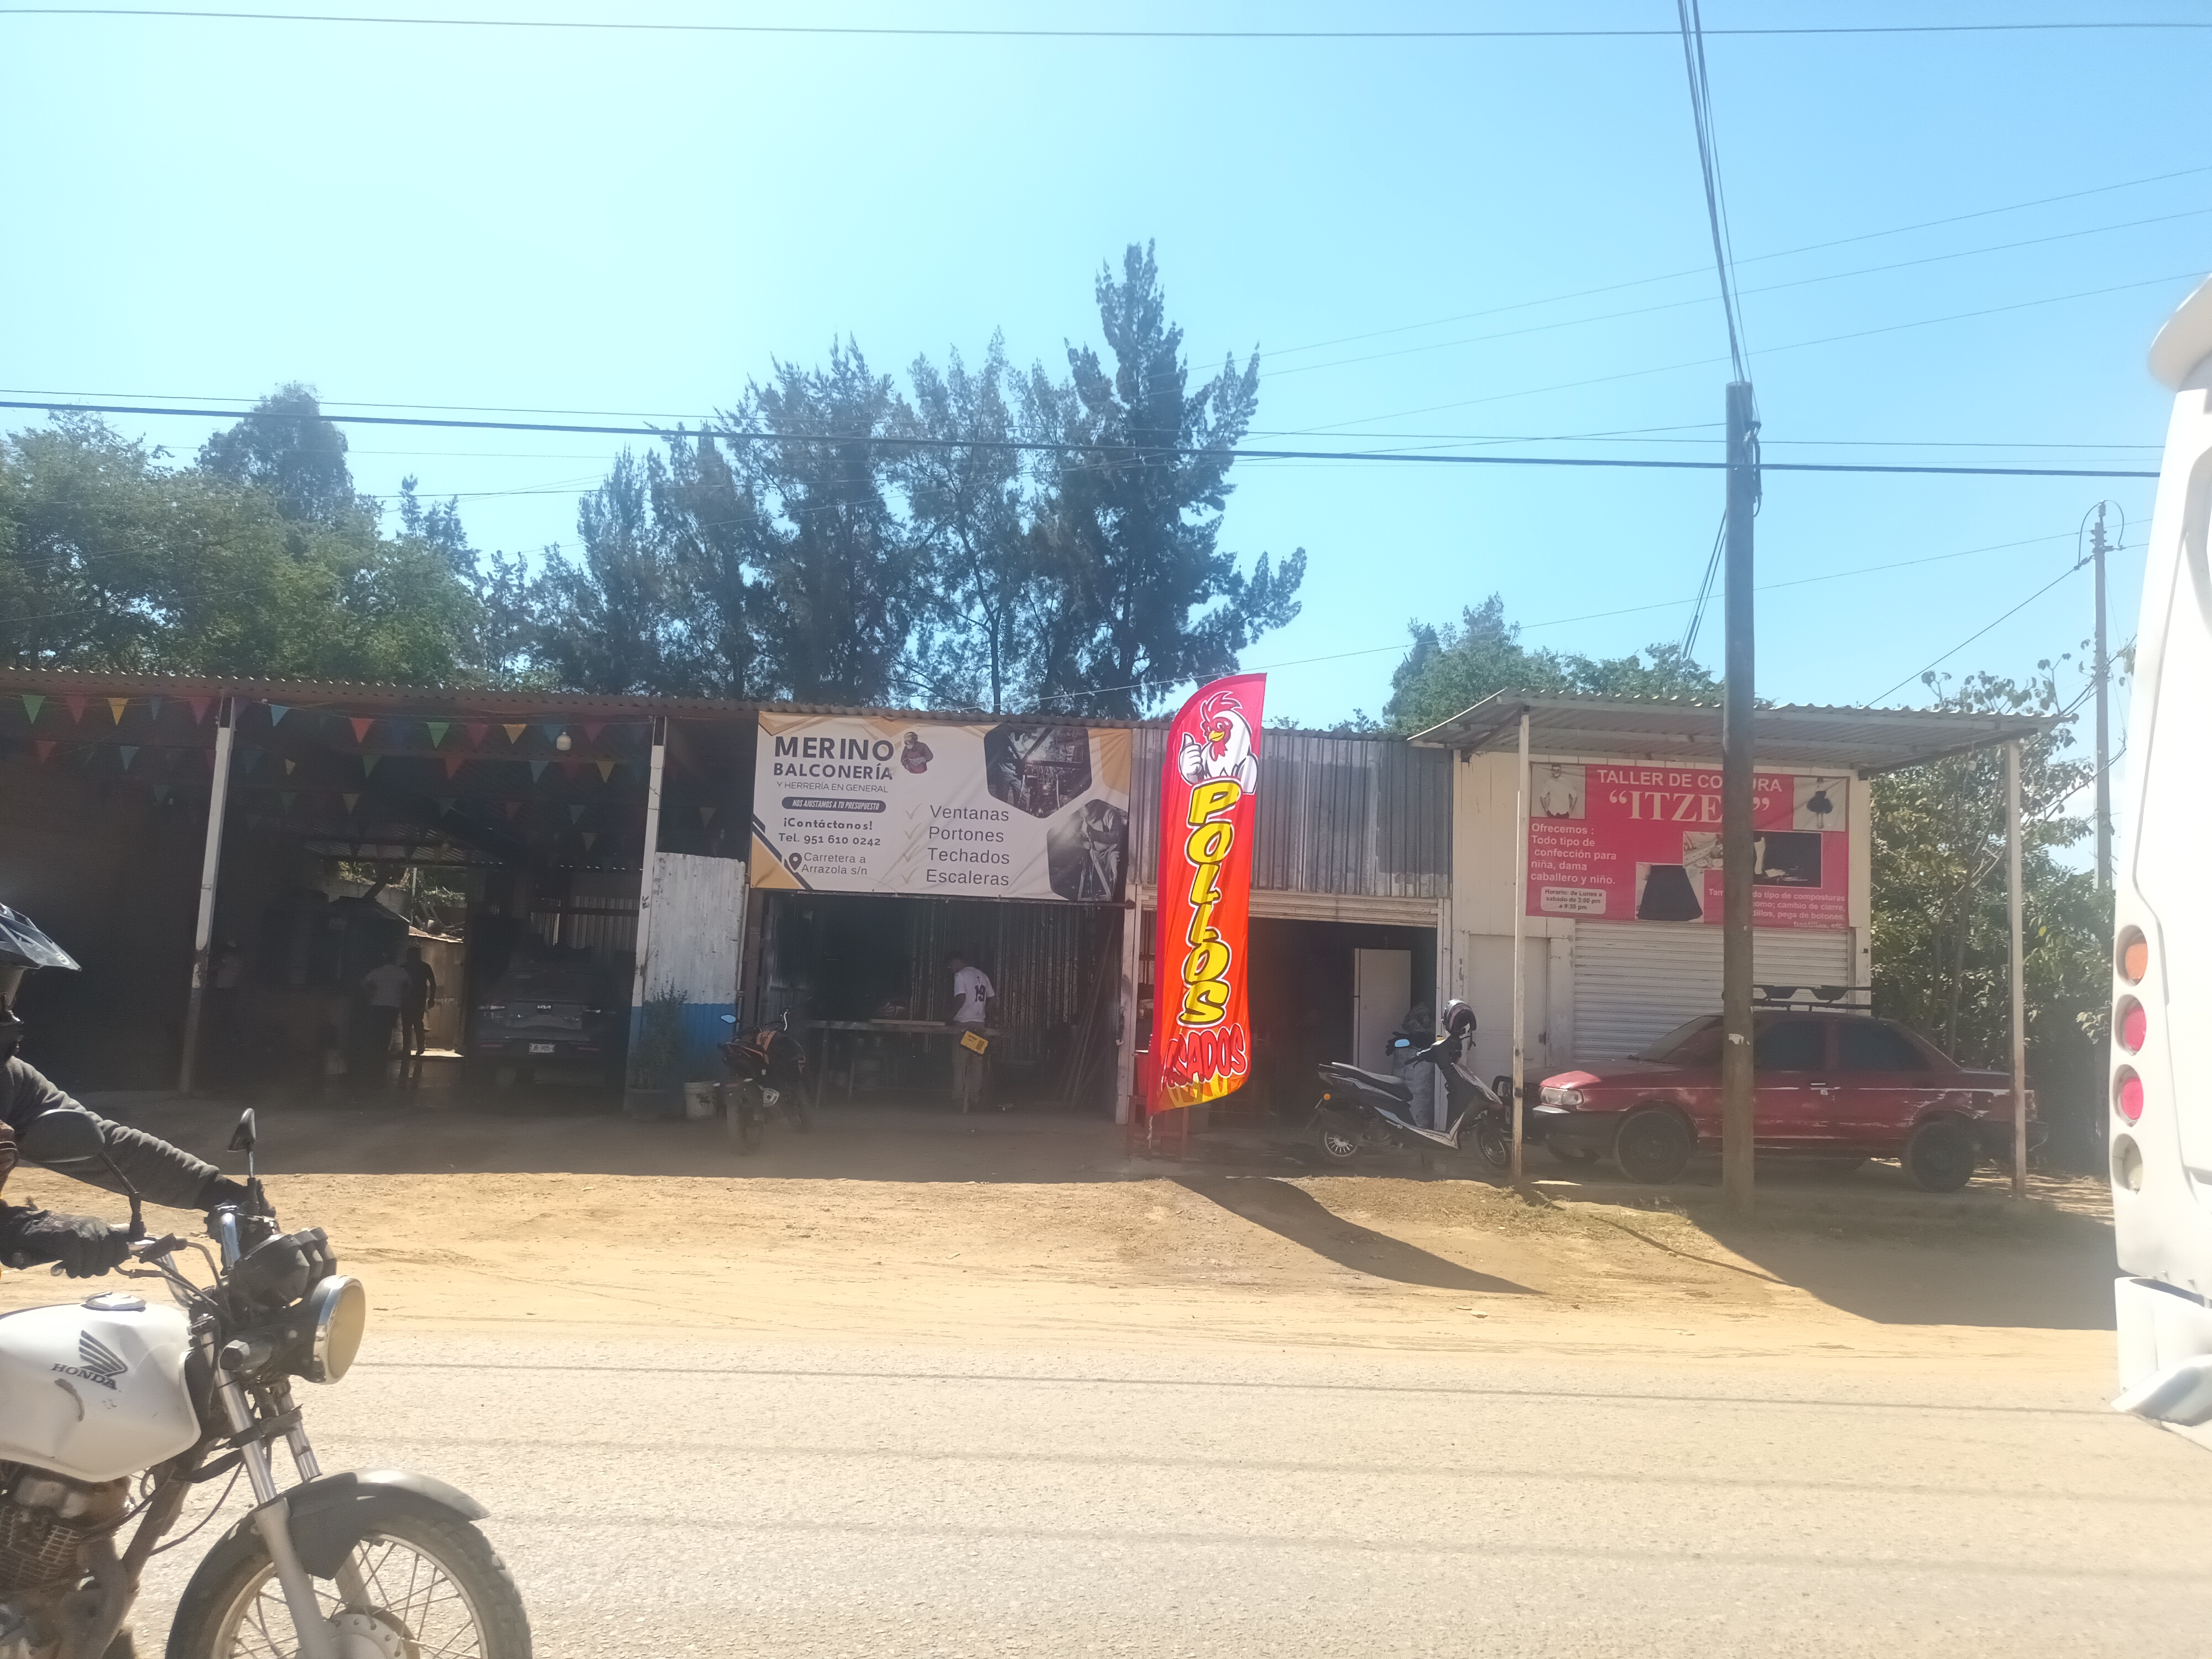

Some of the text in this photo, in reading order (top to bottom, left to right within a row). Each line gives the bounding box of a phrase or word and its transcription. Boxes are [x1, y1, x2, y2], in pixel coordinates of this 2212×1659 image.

[775, 736, 894, 761] MERINO
[774, 763, 893, 780] BALCONERÍA
[785, 781, 830, 790] HERRERÍA
[846, 784, 889, 793] GENERAL
[1597, 769, 1782, 792] TALLER DE CORA
[792, 799, 804, 807] NOS
[804, 800, 832, 808] AJUSTAMOS
[844, 802, 880, 810] PRESUPUESTO
[930, 805, 1009, 821] Ventanas
[784, 817, 873, 830] ¡Contáctanos!
[1531, 823, 1588, 834] Ofrecemos
[779, 833, 880, 847] Tel. 951 610 0242
[929, 826, 1004, 842] Portones
[1531, 835, 1595, 848] Todo tipo de
[804, 852, 855, 863] Carretera
[927, 847, 1010, 864] Techados
[1534, 848, 1616, 861] confección para
[801, 864, 867, 875] Arrazola s/n
[1531, 859, 1587, 870] niña, dama
[926, 869, 1009, 886] Escaleras
[1531, 872, 1615, 885] caballero y niño.
[1178, 780, 1241, 1025] POLLOS
[1764, 891, 1780, 900] tipo
[1793, 894, 1845, 902] composturas
[974, 984, 986, 1002] 19
[51, 1363, 118, 1390] HONDA
